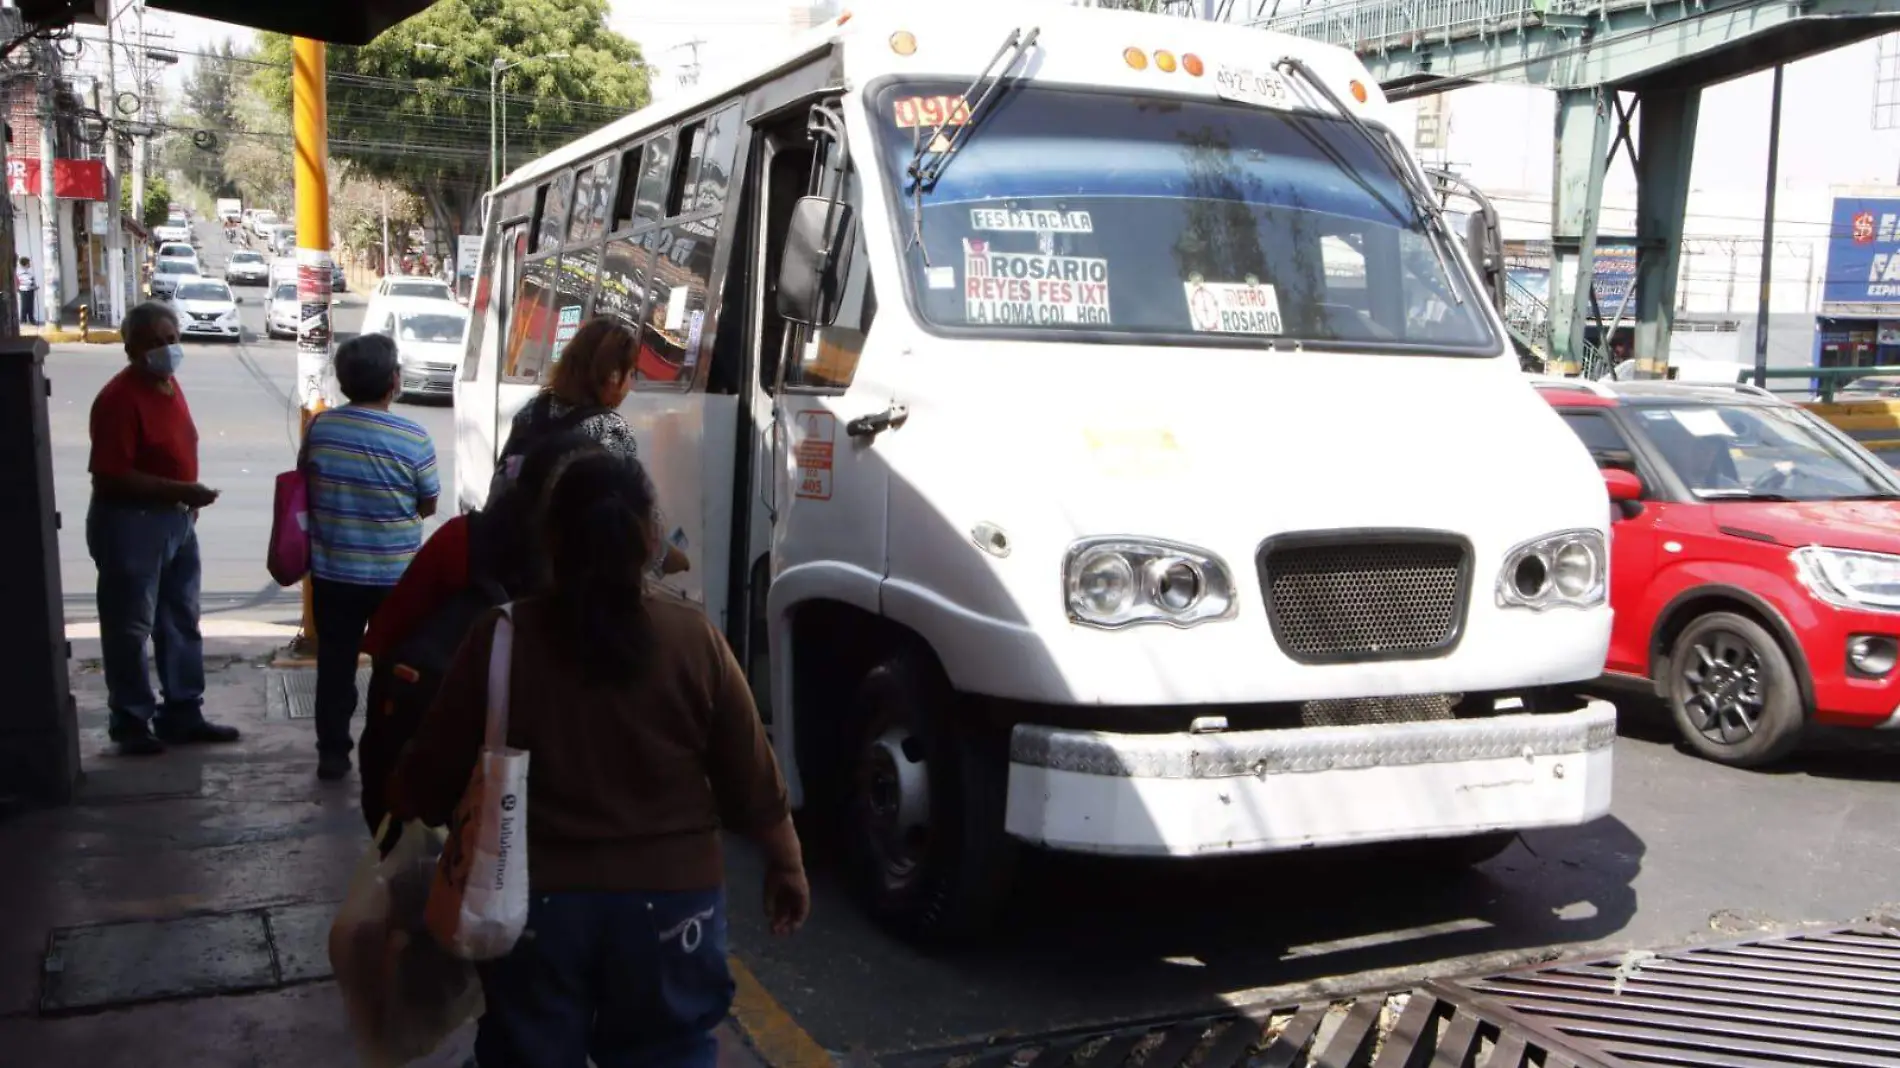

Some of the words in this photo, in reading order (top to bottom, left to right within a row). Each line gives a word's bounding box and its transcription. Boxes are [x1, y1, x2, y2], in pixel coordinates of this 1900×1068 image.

[992, 256, 1106, 282] ROSARIO
[967, 277, 1032, 302] REYES
[1037, 280, 1073, 304] FES
[1077, 283, 1107, 305] IXT
[967, 301, 987, 323] LA
[992, 301, 1035, 324] LOMA
[1221, 310, 1280, 331] ROSARIO
[495, 817, 513, 890] lululemon
